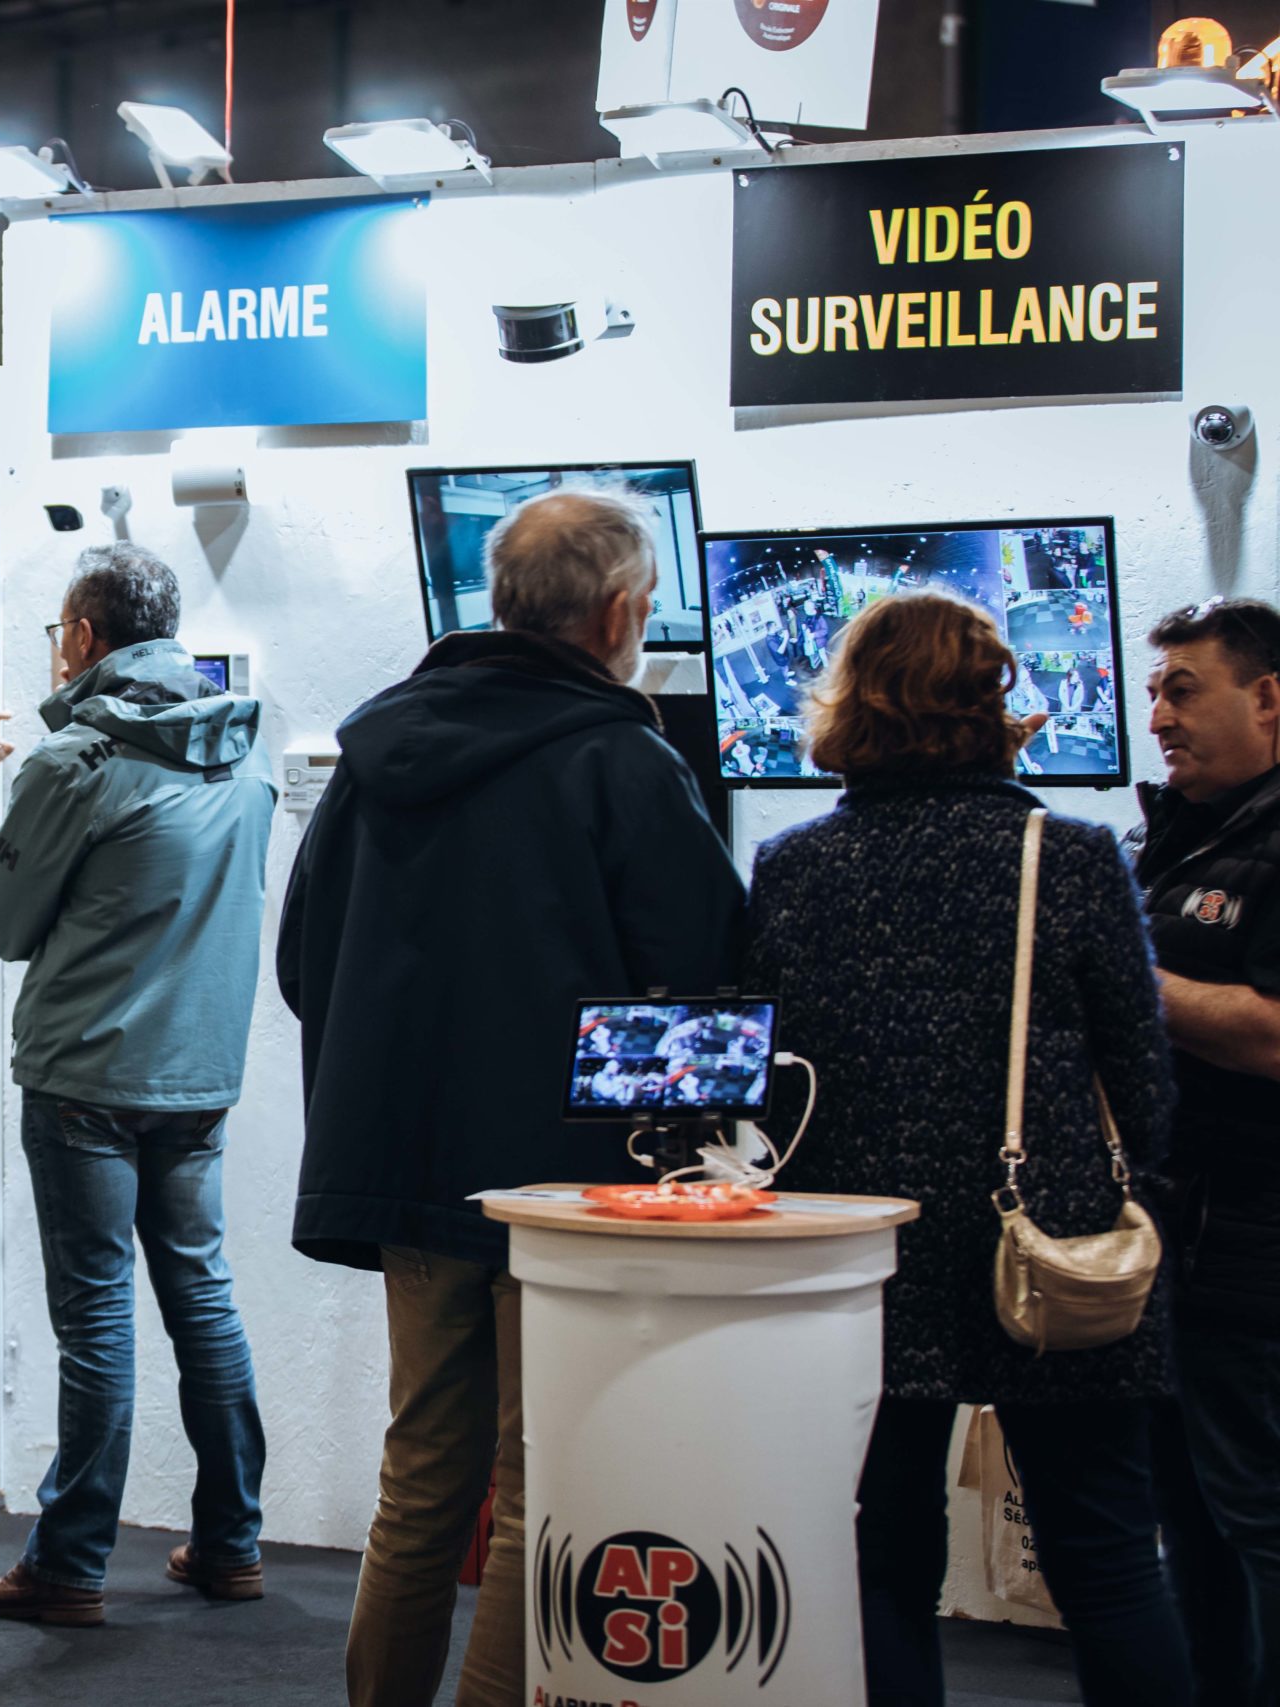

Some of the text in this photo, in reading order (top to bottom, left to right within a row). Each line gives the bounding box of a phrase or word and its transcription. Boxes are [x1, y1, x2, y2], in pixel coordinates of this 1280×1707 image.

[869, 190, 1032, 265] VIDÉO
[138, 284, 328, 345] ALARME
[750, 281, 1158, 356] SURVEILLANCE
[1004, 1491, 1024, 1508] AL
[593, 1544, 698, 1600] AP
[602, 1600, 688, 1668] Si
